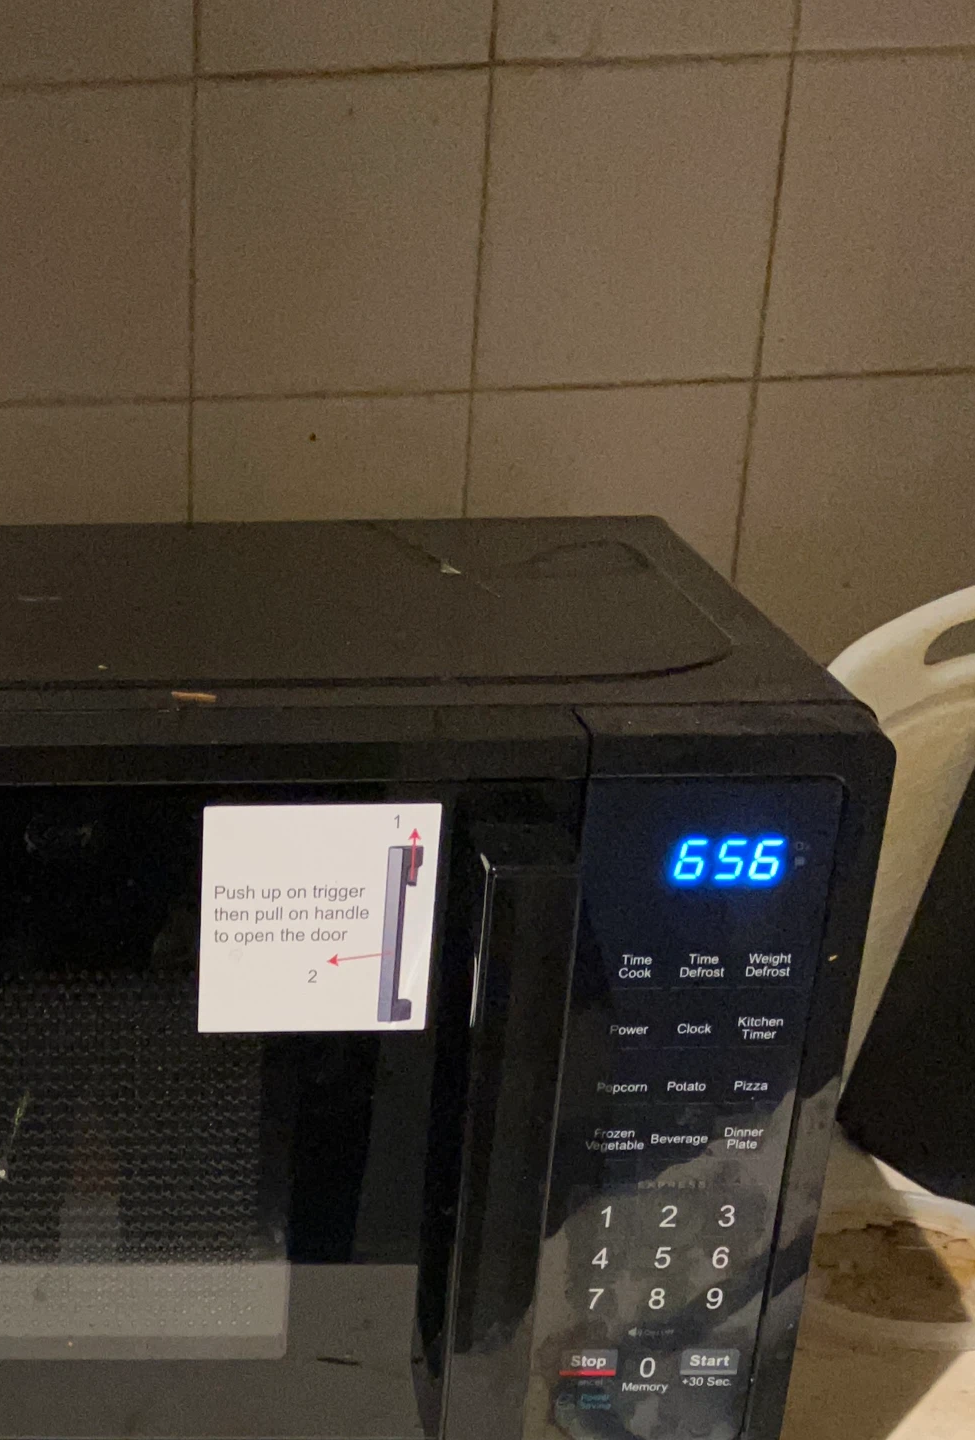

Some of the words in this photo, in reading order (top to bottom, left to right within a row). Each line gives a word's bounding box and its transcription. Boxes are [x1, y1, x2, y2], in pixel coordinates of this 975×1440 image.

[393, 814, 401, 829] 1
[672, 838, 785, 881] 656
[214, 885, 255, 900] Push
[261, 888, 281, 902] up
[286, 887, 307, 899] on
[313, 884, 366, 902] trigger
[214, 907, 249, 921] then
[255, 907, 283, 924] pull
[288, 909, 309, 921] on
[314, 906, 370, 920] handle
[214, 929, 229, 943] to
[234, 931, 274, 946] open
[280, 929, 306, 942] the
[310, 928, 348, 941] door
[622, 954, 653, 966] Time
[688, 953, 720, 965] Time
[748, 952, 792, 967] Weight
[307, 969, 318, 983] 2
[618, 967, 652, 979] Cook
[679, 966, 725, 979] Defrost
[745, 966, 791, 978] Defrost
[677, 1023, 712, 1035] Clock
[737, 1016, 784, 1028] Kitchen
[610, 1024, 649, 1036] Power
[741, 1028, 777, 1040] Timer
[596, 1081, 648, 1095] Popcorn
[666, 1081, 707, 1092] Potato
[734, 1080, 768, 1092] Pizza
[594, 1128, 636, 1139] Frozen
[651, 1133, 709, 1146] Beverage
[724, 1127, 764, 1138] Dinner
[585, 1139, 645, 1153] Vegetable
[726, 1138, 758, 1150] Plate
[601, 1205, 612, 1228] 1
[659, 1205, 678, 1228] 2
[718, 1204, 736, 1228] 3
[591, 1247, 609, 1270] 4
[654, 1246, 672, 1269] 5
[712, 1246, 730, 1269] 6
[588, 1288, 605, 1310] 7
[648, 1287, 666, 1310] 8
[706, 1287, 724, 1310] 9
[570, 1355, 607, 1369] Stop
[639, 1356, 656, 1379] 0
[689, 1354, 730, 1367] Start
[621, 1382, 669, 1393] Memory
[682, 1376, 704, 1387] +30
[706, 1376, 732, 1387] Sec.
